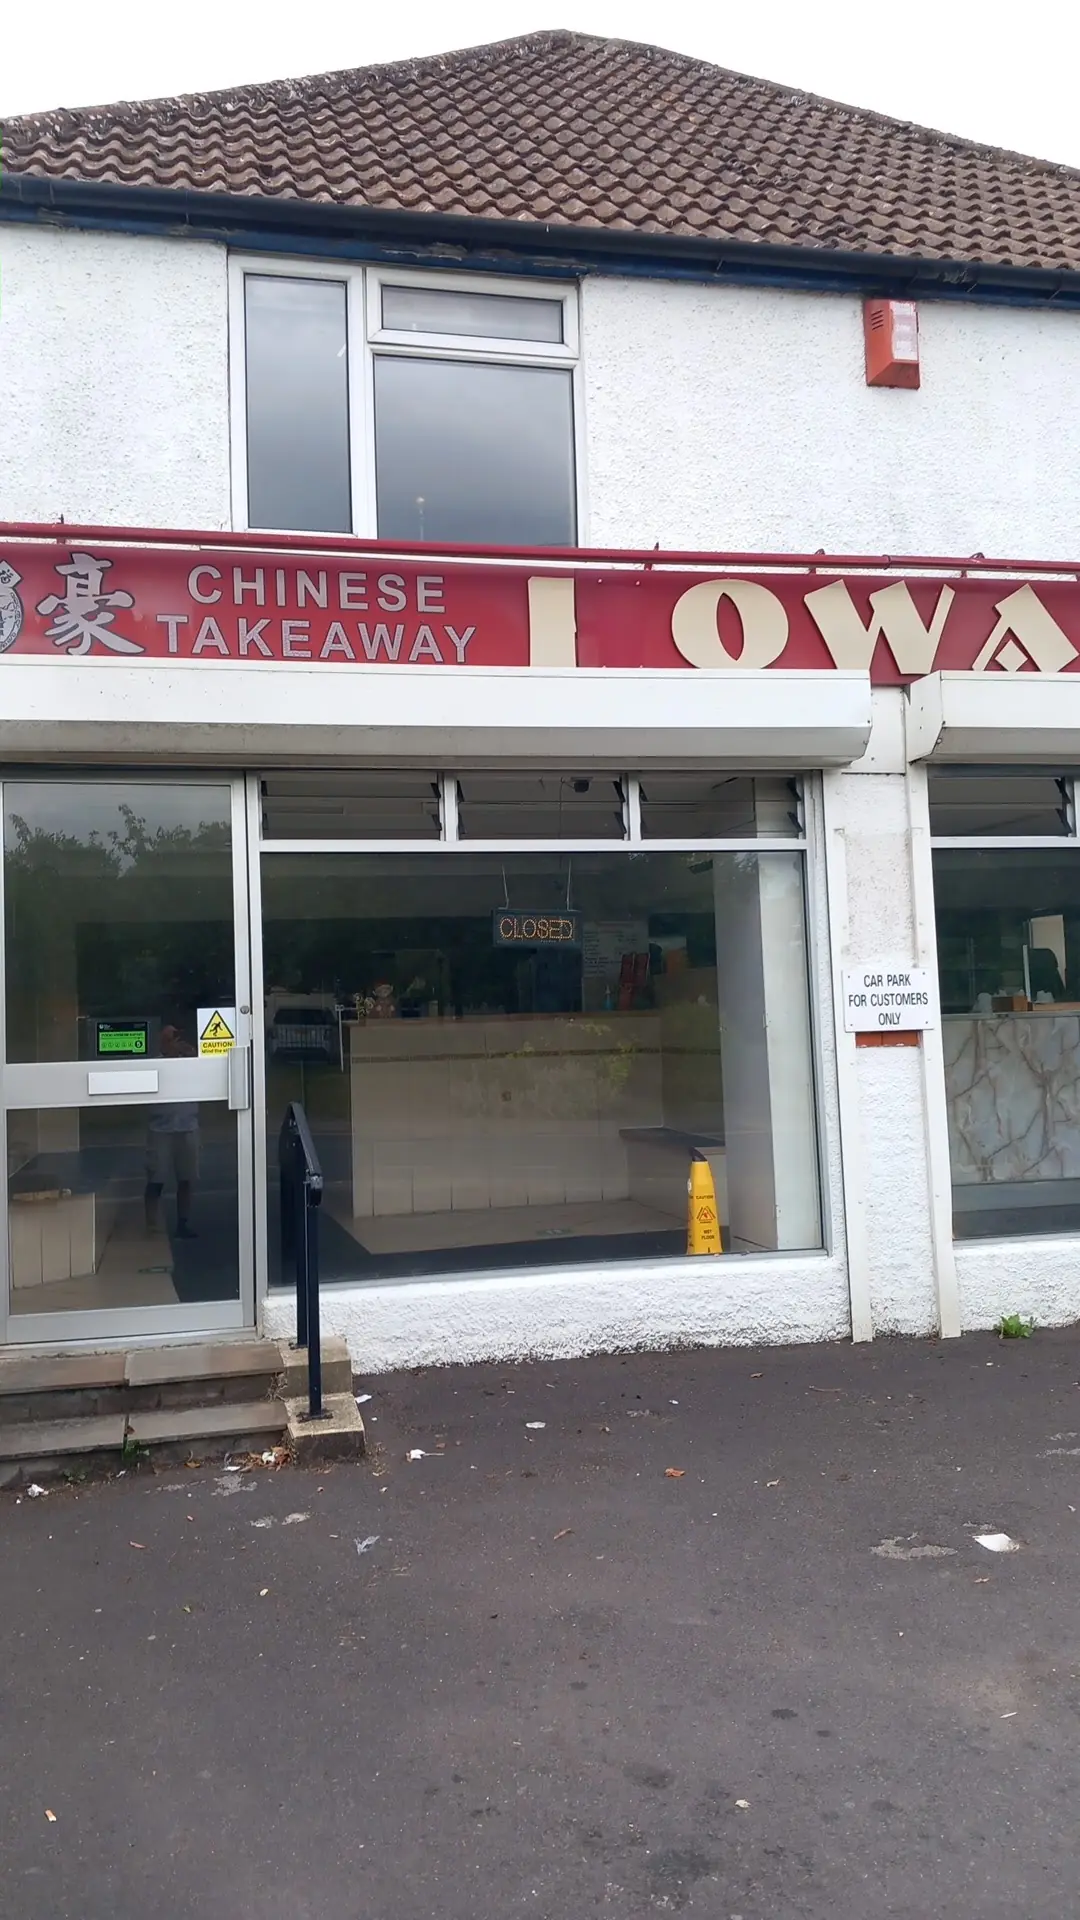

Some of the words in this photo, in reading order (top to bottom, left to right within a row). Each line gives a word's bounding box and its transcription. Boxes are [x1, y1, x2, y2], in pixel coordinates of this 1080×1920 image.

[188, 564, 446, 613] CHINESE
[156, 614, 477, 663] TAKEAWAY
[500, 918, 573, 940] CLOSED
[864, 975, 883, 987] CAR
[887, 974, 911, 986] PARK
[848, 994, 867, 1007] FOR
[870, 992, 928, 1006] CUSTOMERS
[878, 1013, 901, 1025] ONLY
